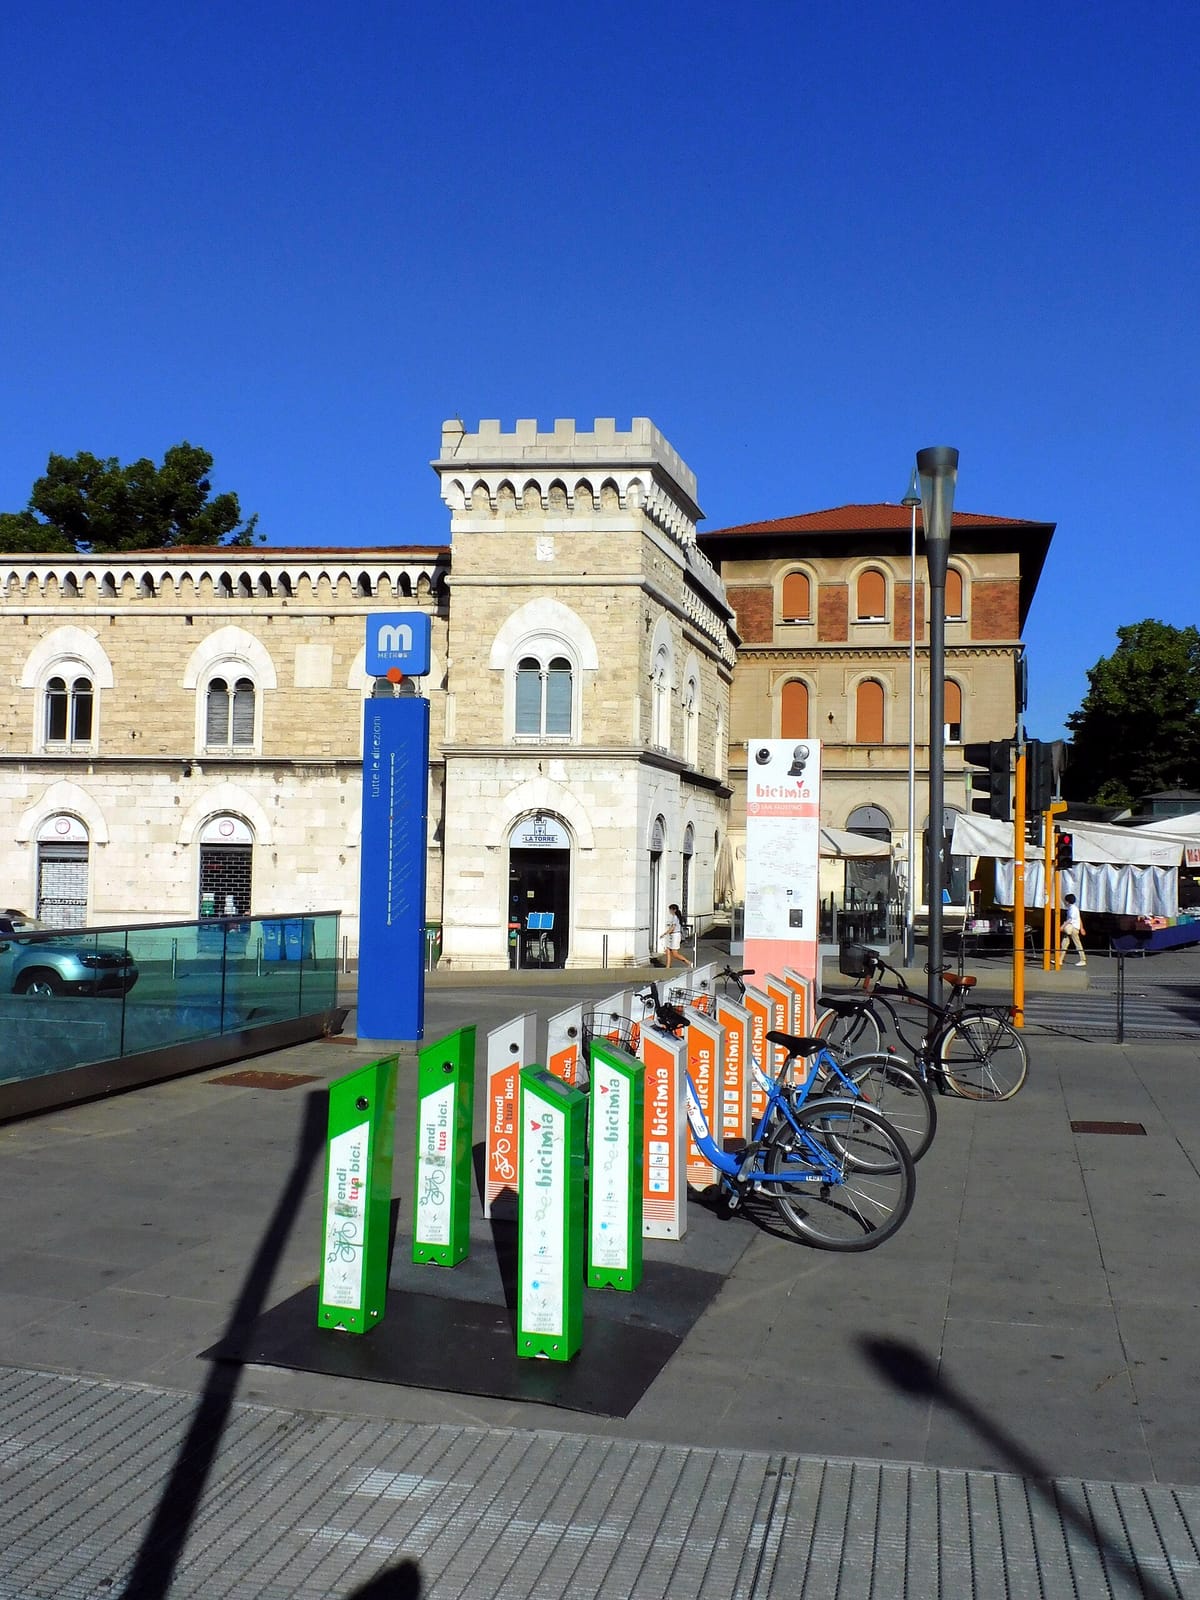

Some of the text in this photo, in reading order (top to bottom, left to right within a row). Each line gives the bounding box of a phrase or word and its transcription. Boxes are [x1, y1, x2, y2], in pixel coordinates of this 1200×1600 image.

[370, 715, 381, 797] tutte le direzioni
[756, 780, 810, 798] bicimia
[724, 1032, 739, 1085] bicimia
[437, 1100, 448, 1127] bici.
[494, 1096, 504, 1134] Prendi
[504, 1075, 514, 1134] la tua bici.
[604, 1079, 620, 1142] bicimia
[651, 1068, 669, 1136] bicimia
[349, 1142, 361, 1172] bici.
[438, 1131, 447, 1151] tua
[535, 1113, 553, 1187] bicimia
[348, 1177, 360, 1200] tua
